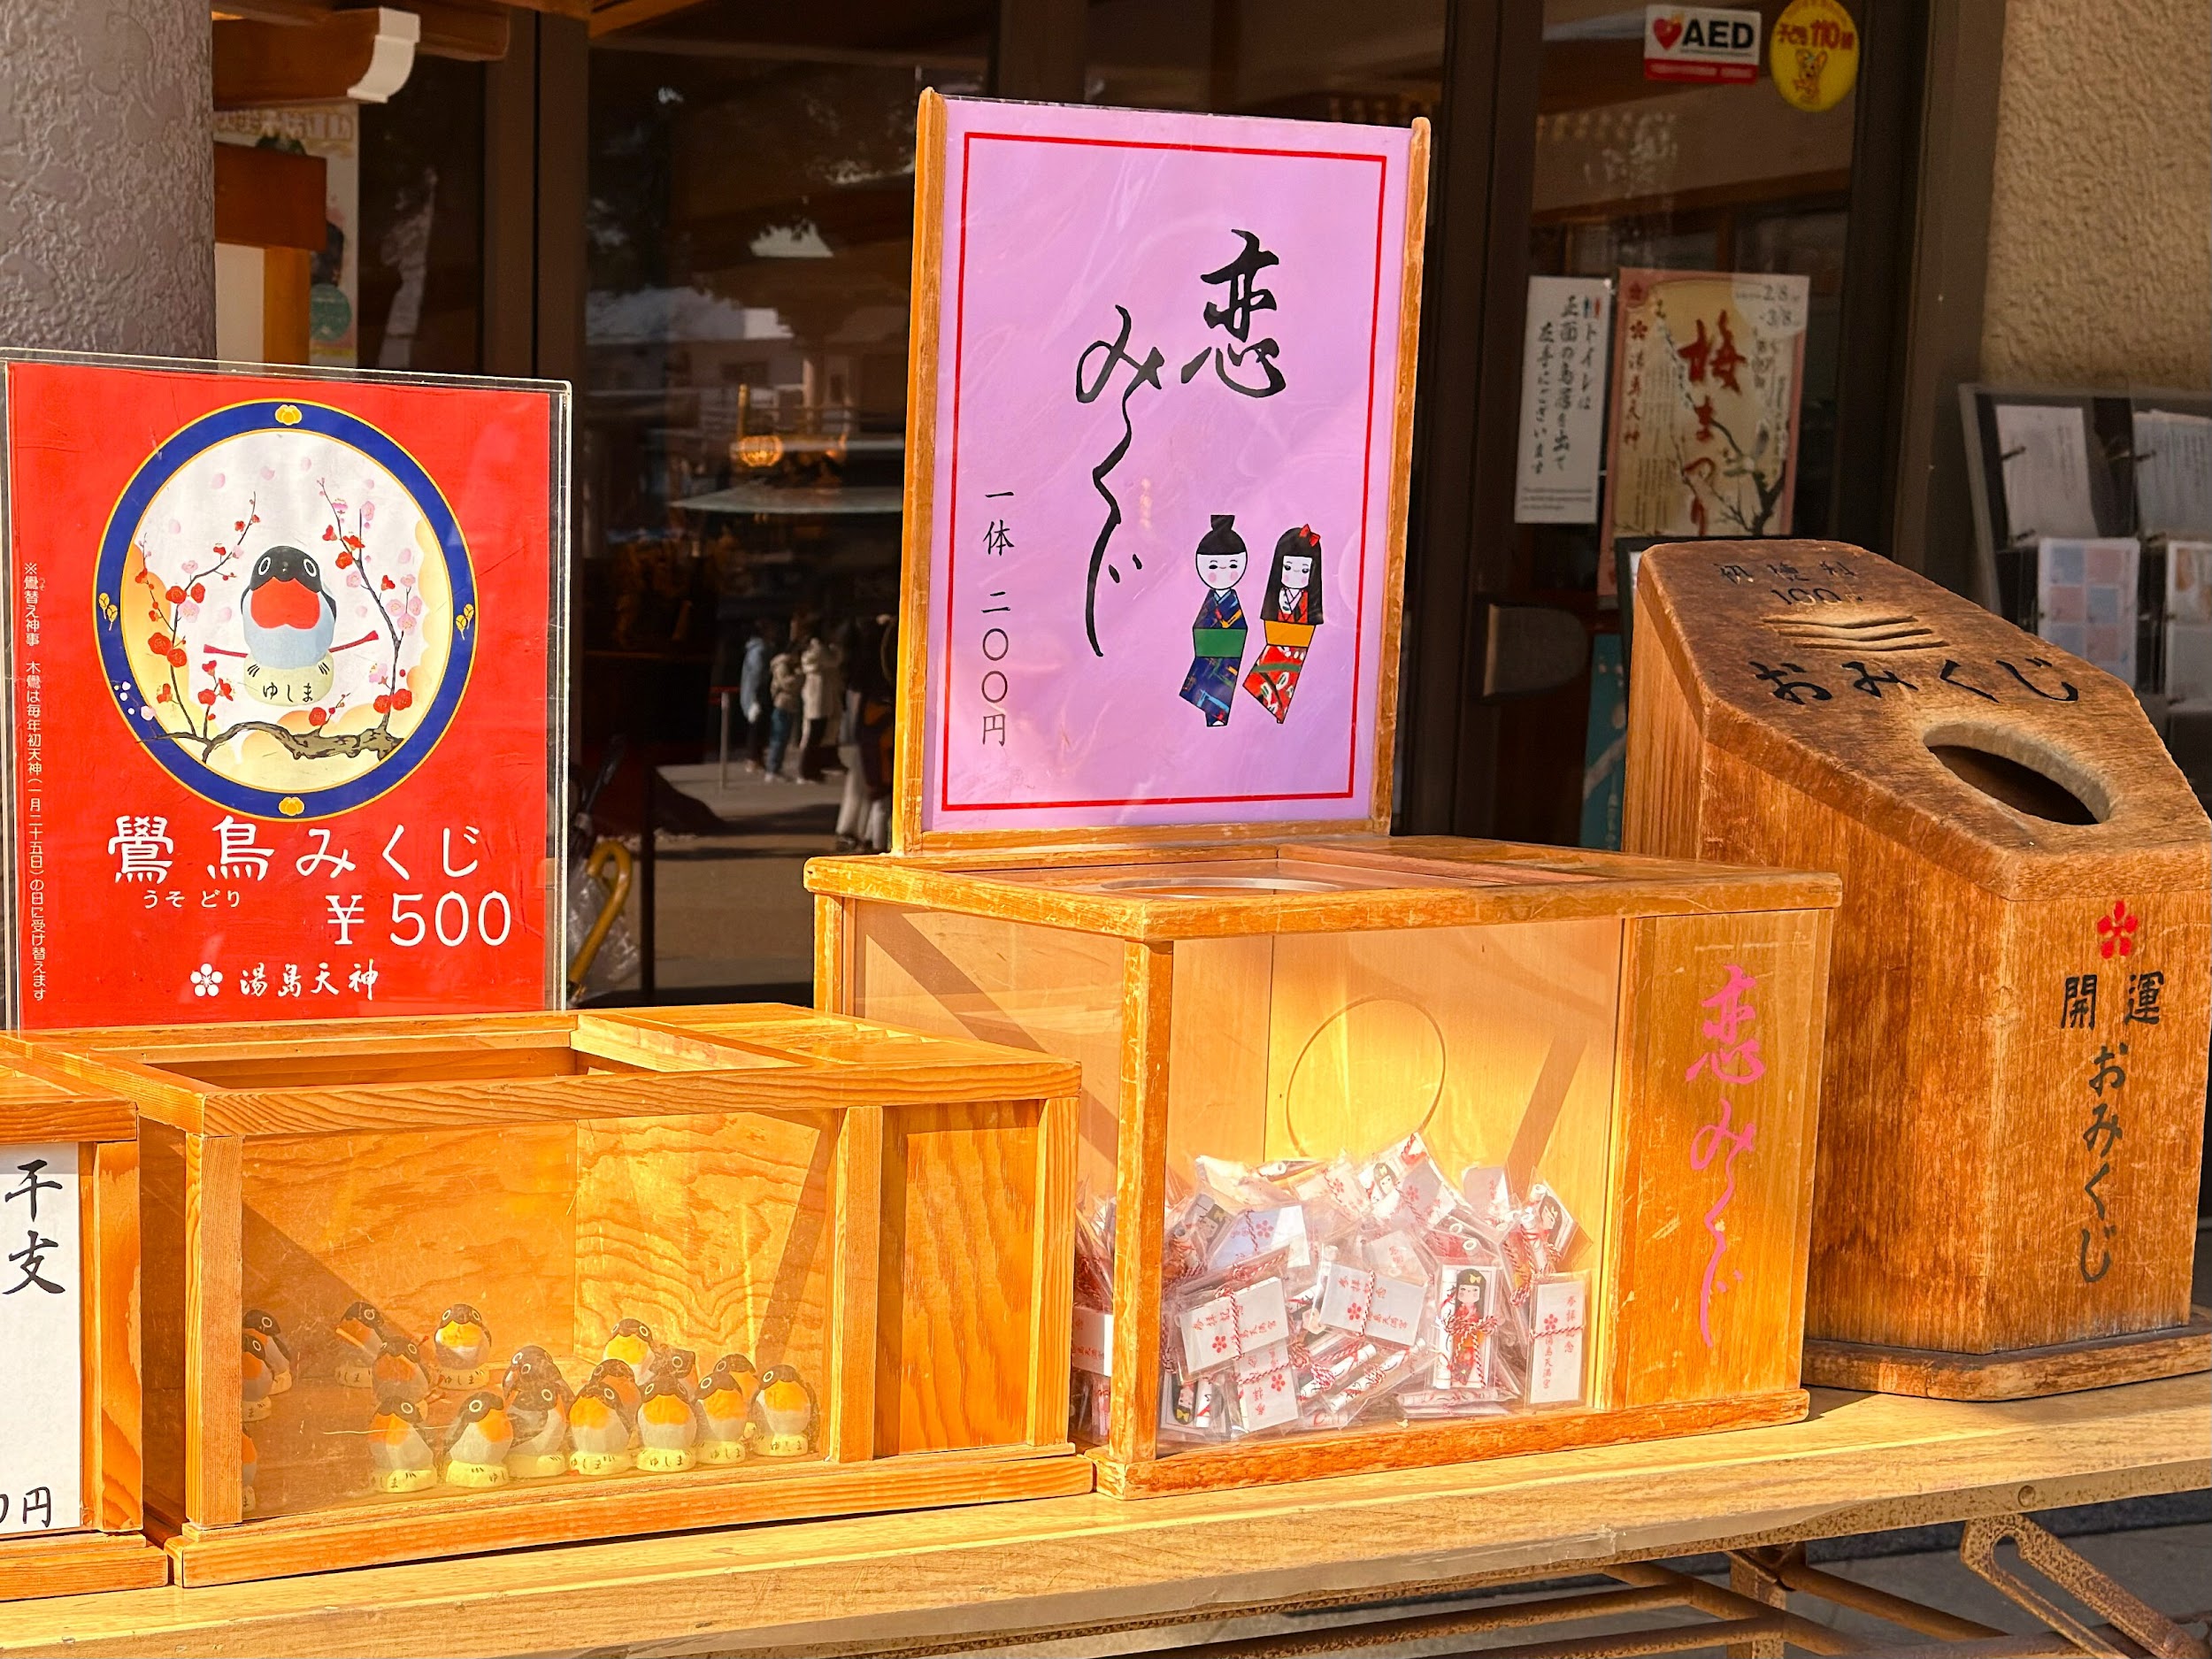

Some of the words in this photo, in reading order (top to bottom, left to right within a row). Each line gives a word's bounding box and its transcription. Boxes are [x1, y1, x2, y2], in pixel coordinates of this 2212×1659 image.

[1682, 19, 1755, 50] AED
[1181, 229, 1286, 398] 恋
[1076, 304, 1164, 657] みくじ
[983, 490, 1016, 557] 一体
[262, 681, 313, 703] ゆしま
[1748, 657, 2078, 705] おみくじ
[326, 890, 511, 947] ¥500
[239, 958, 379, 1001] 湯島天神
[2061, 971, 2164, 1029] 開運
[2079, 1041, 2129, 1284] おみくじ
